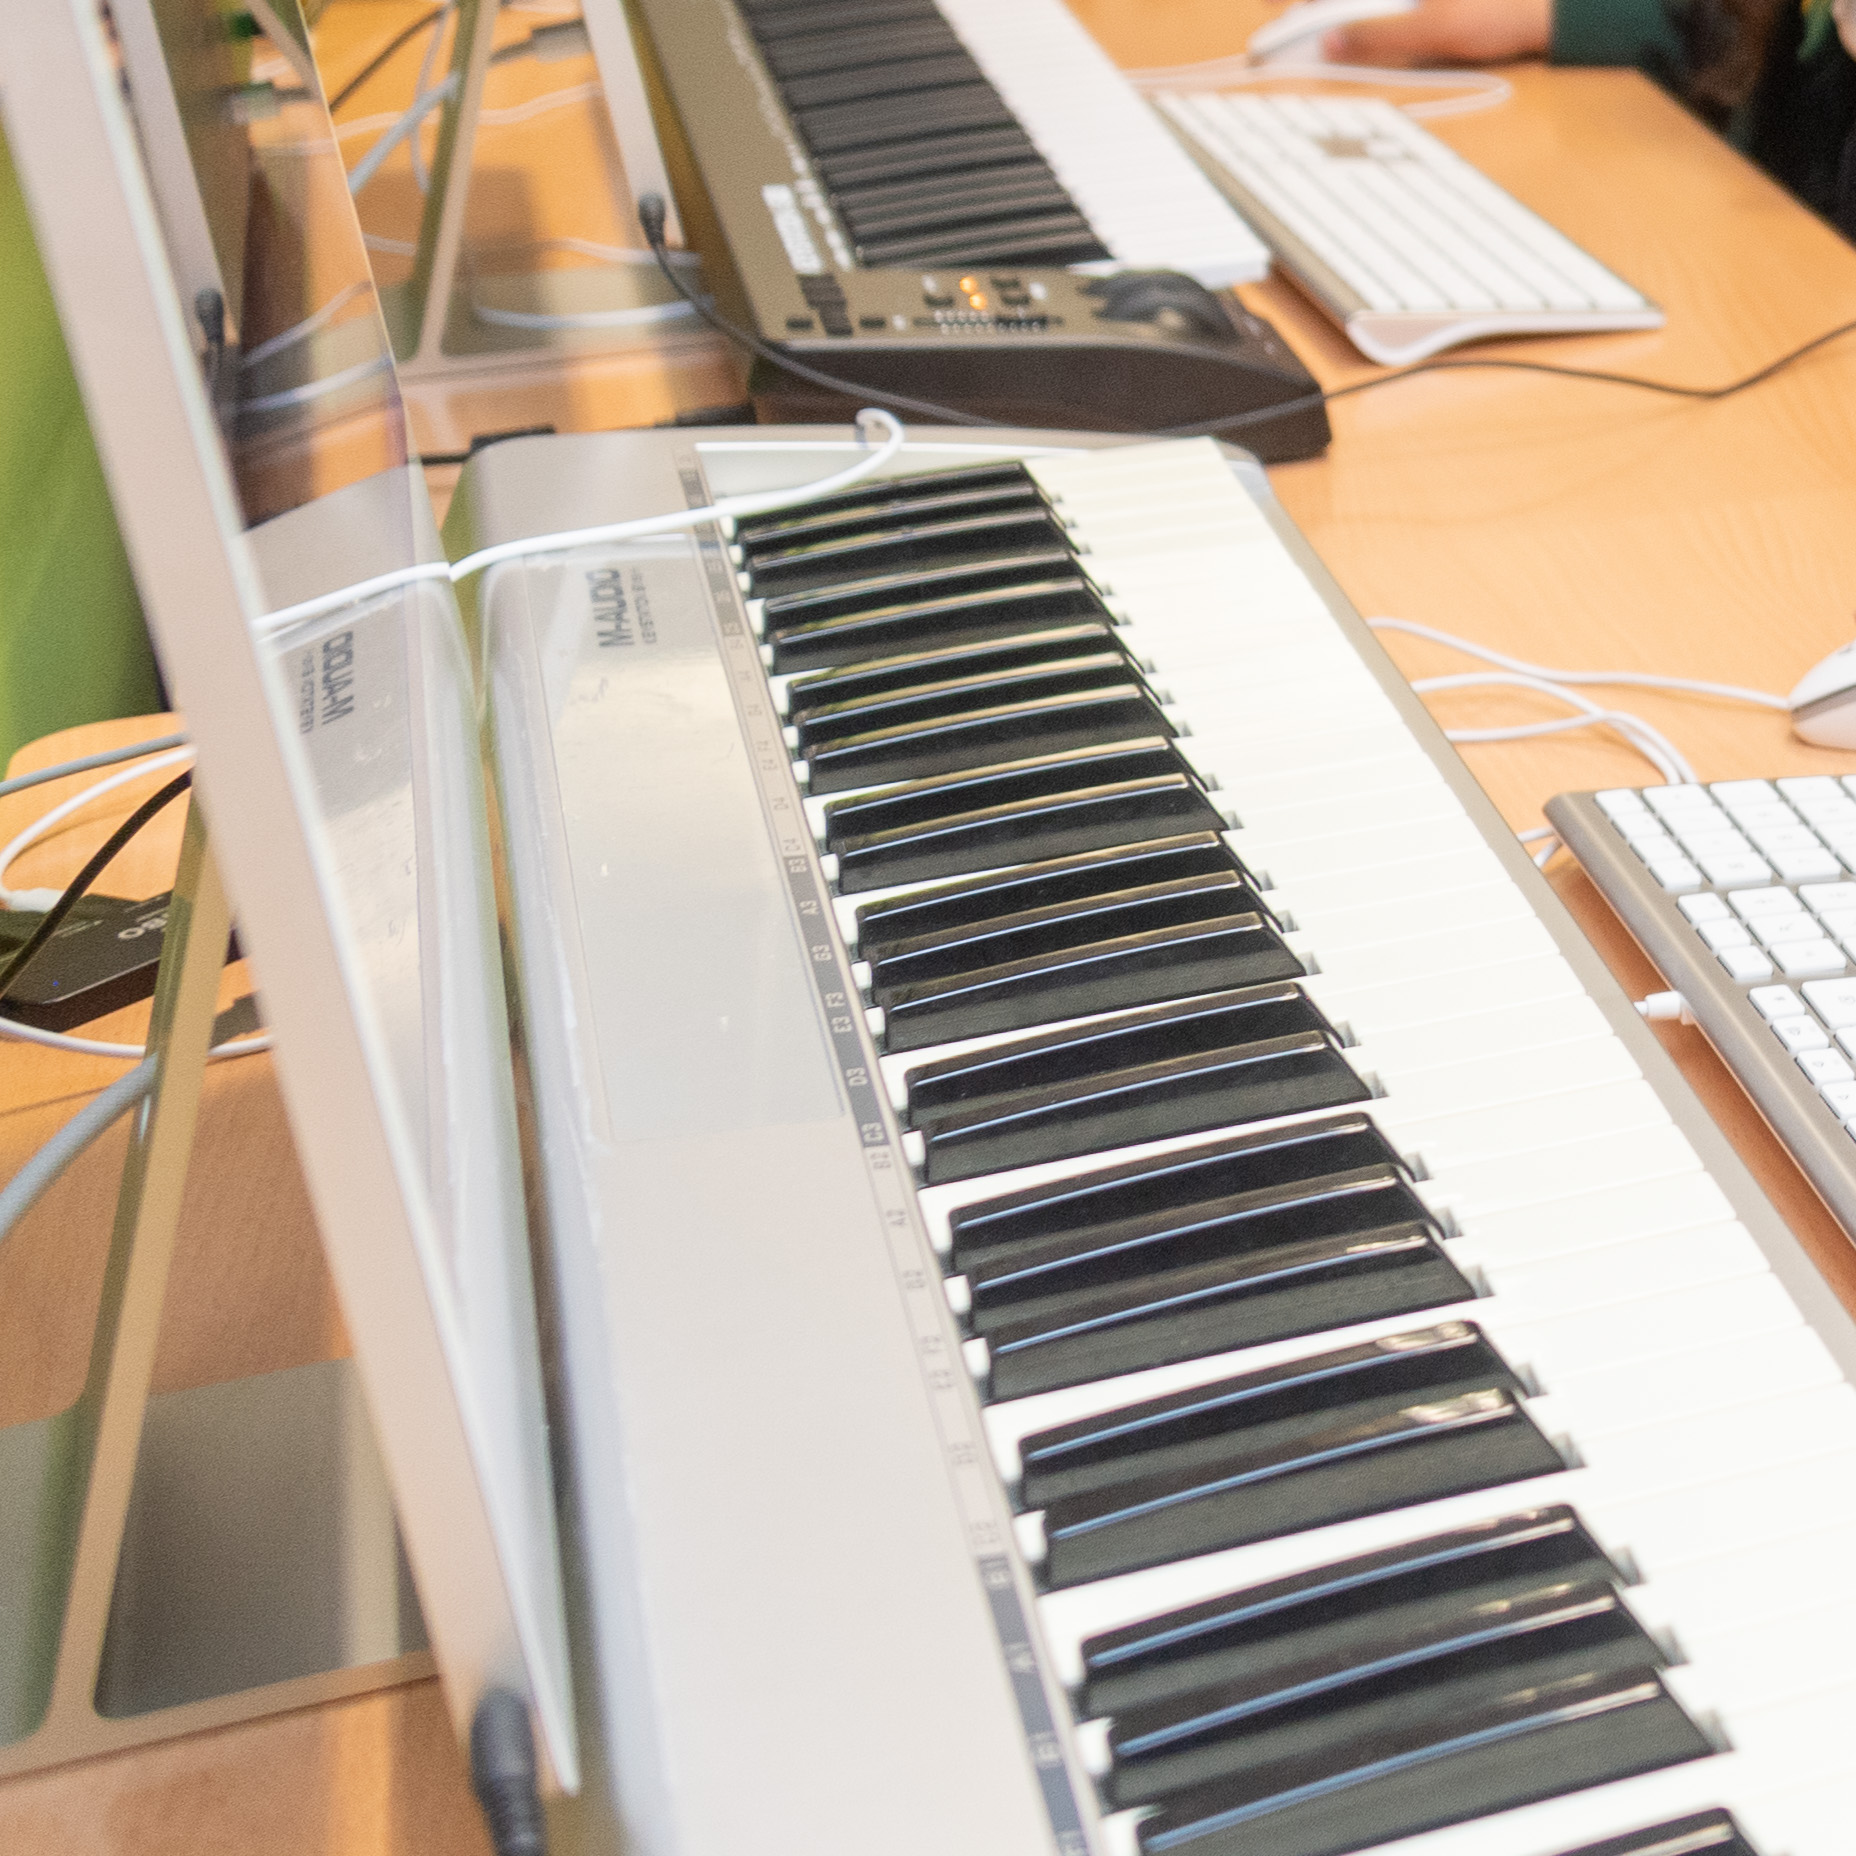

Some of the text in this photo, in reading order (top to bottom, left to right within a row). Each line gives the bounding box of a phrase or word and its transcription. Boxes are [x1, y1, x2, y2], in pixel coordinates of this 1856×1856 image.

[586, 568, 635, 648] M-AUDIO
[773, 797, 789, 811] D4
[783, 838, 800, 852] C4
[800, 900, 819, 916] A3
[811, 945, 832, 962] G3
[825, 991, 845, 1009] F3
[833, 1015, 853, 1033] E3
[846, 1067, 867, 1087] D3
[863, 1122, 884, 1142] C3
[870, 1152, 891, 1170] B2
[886, 1209, 906, 1227] A2
